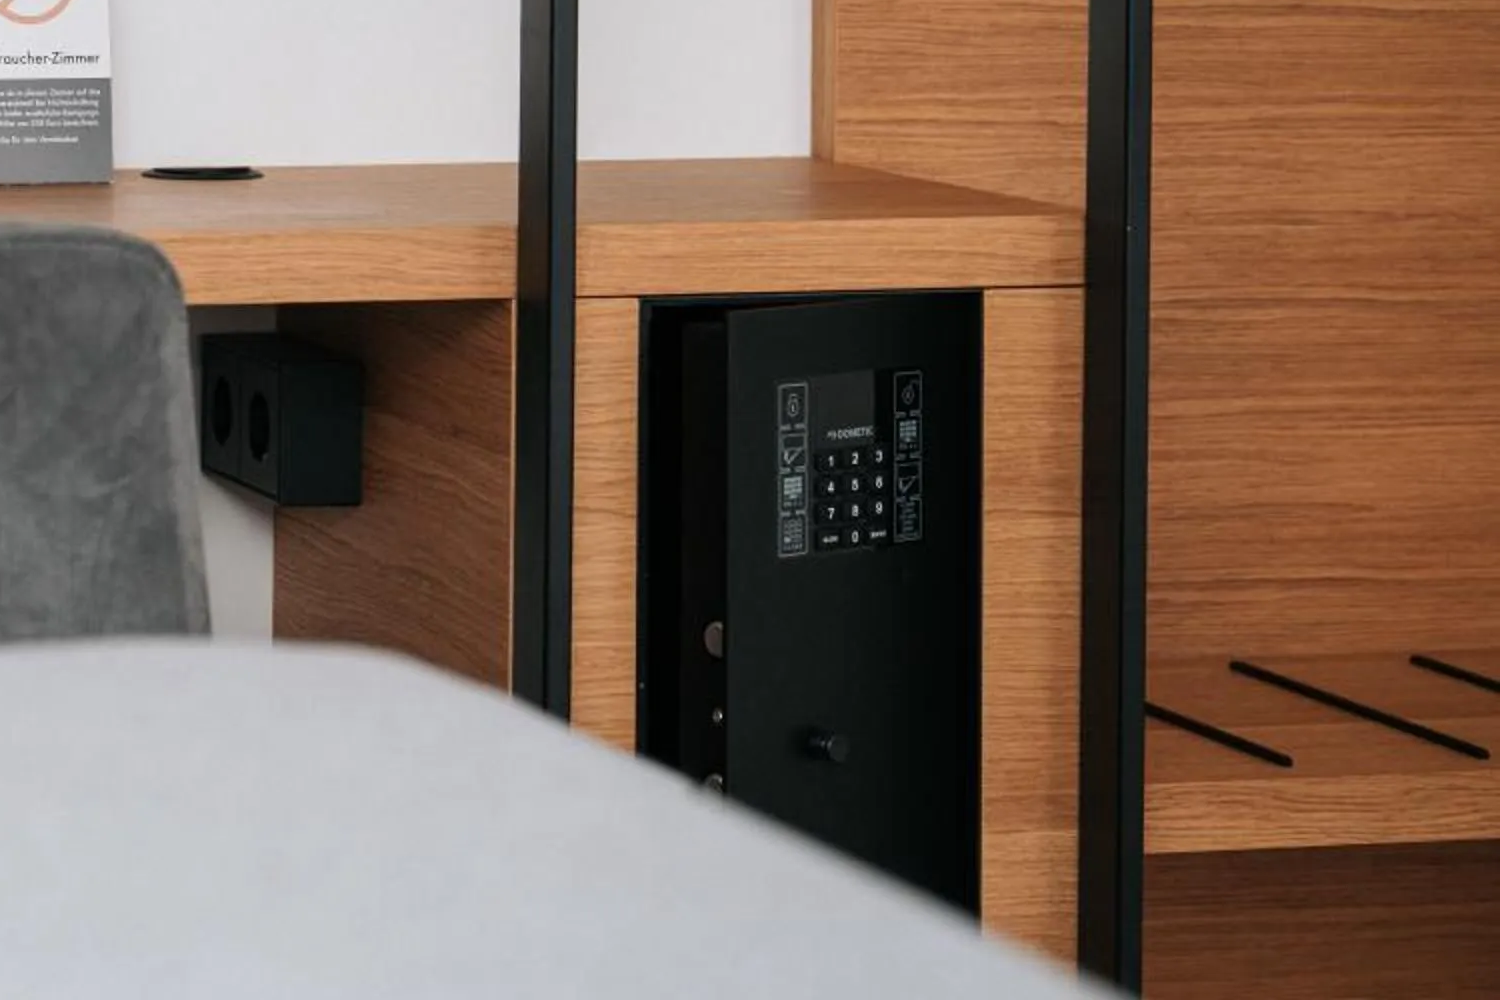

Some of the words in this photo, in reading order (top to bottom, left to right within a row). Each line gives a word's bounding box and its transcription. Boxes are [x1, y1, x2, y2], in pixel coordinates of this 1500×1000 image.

[827, 455, 835, 467] 1
[851, 452, 859, 465] 2
[875, 450, 883, 463] 3
[827, 481, 835, 492] 4
[851, 478, 859, 491] 5
[875, 476, 883, 489] 6
[827, 507, 835, 519] 7
[851, 504, 859, 517] 8
[875, 501, 883, 514] 9
[851, 530, 859, 543] 0
